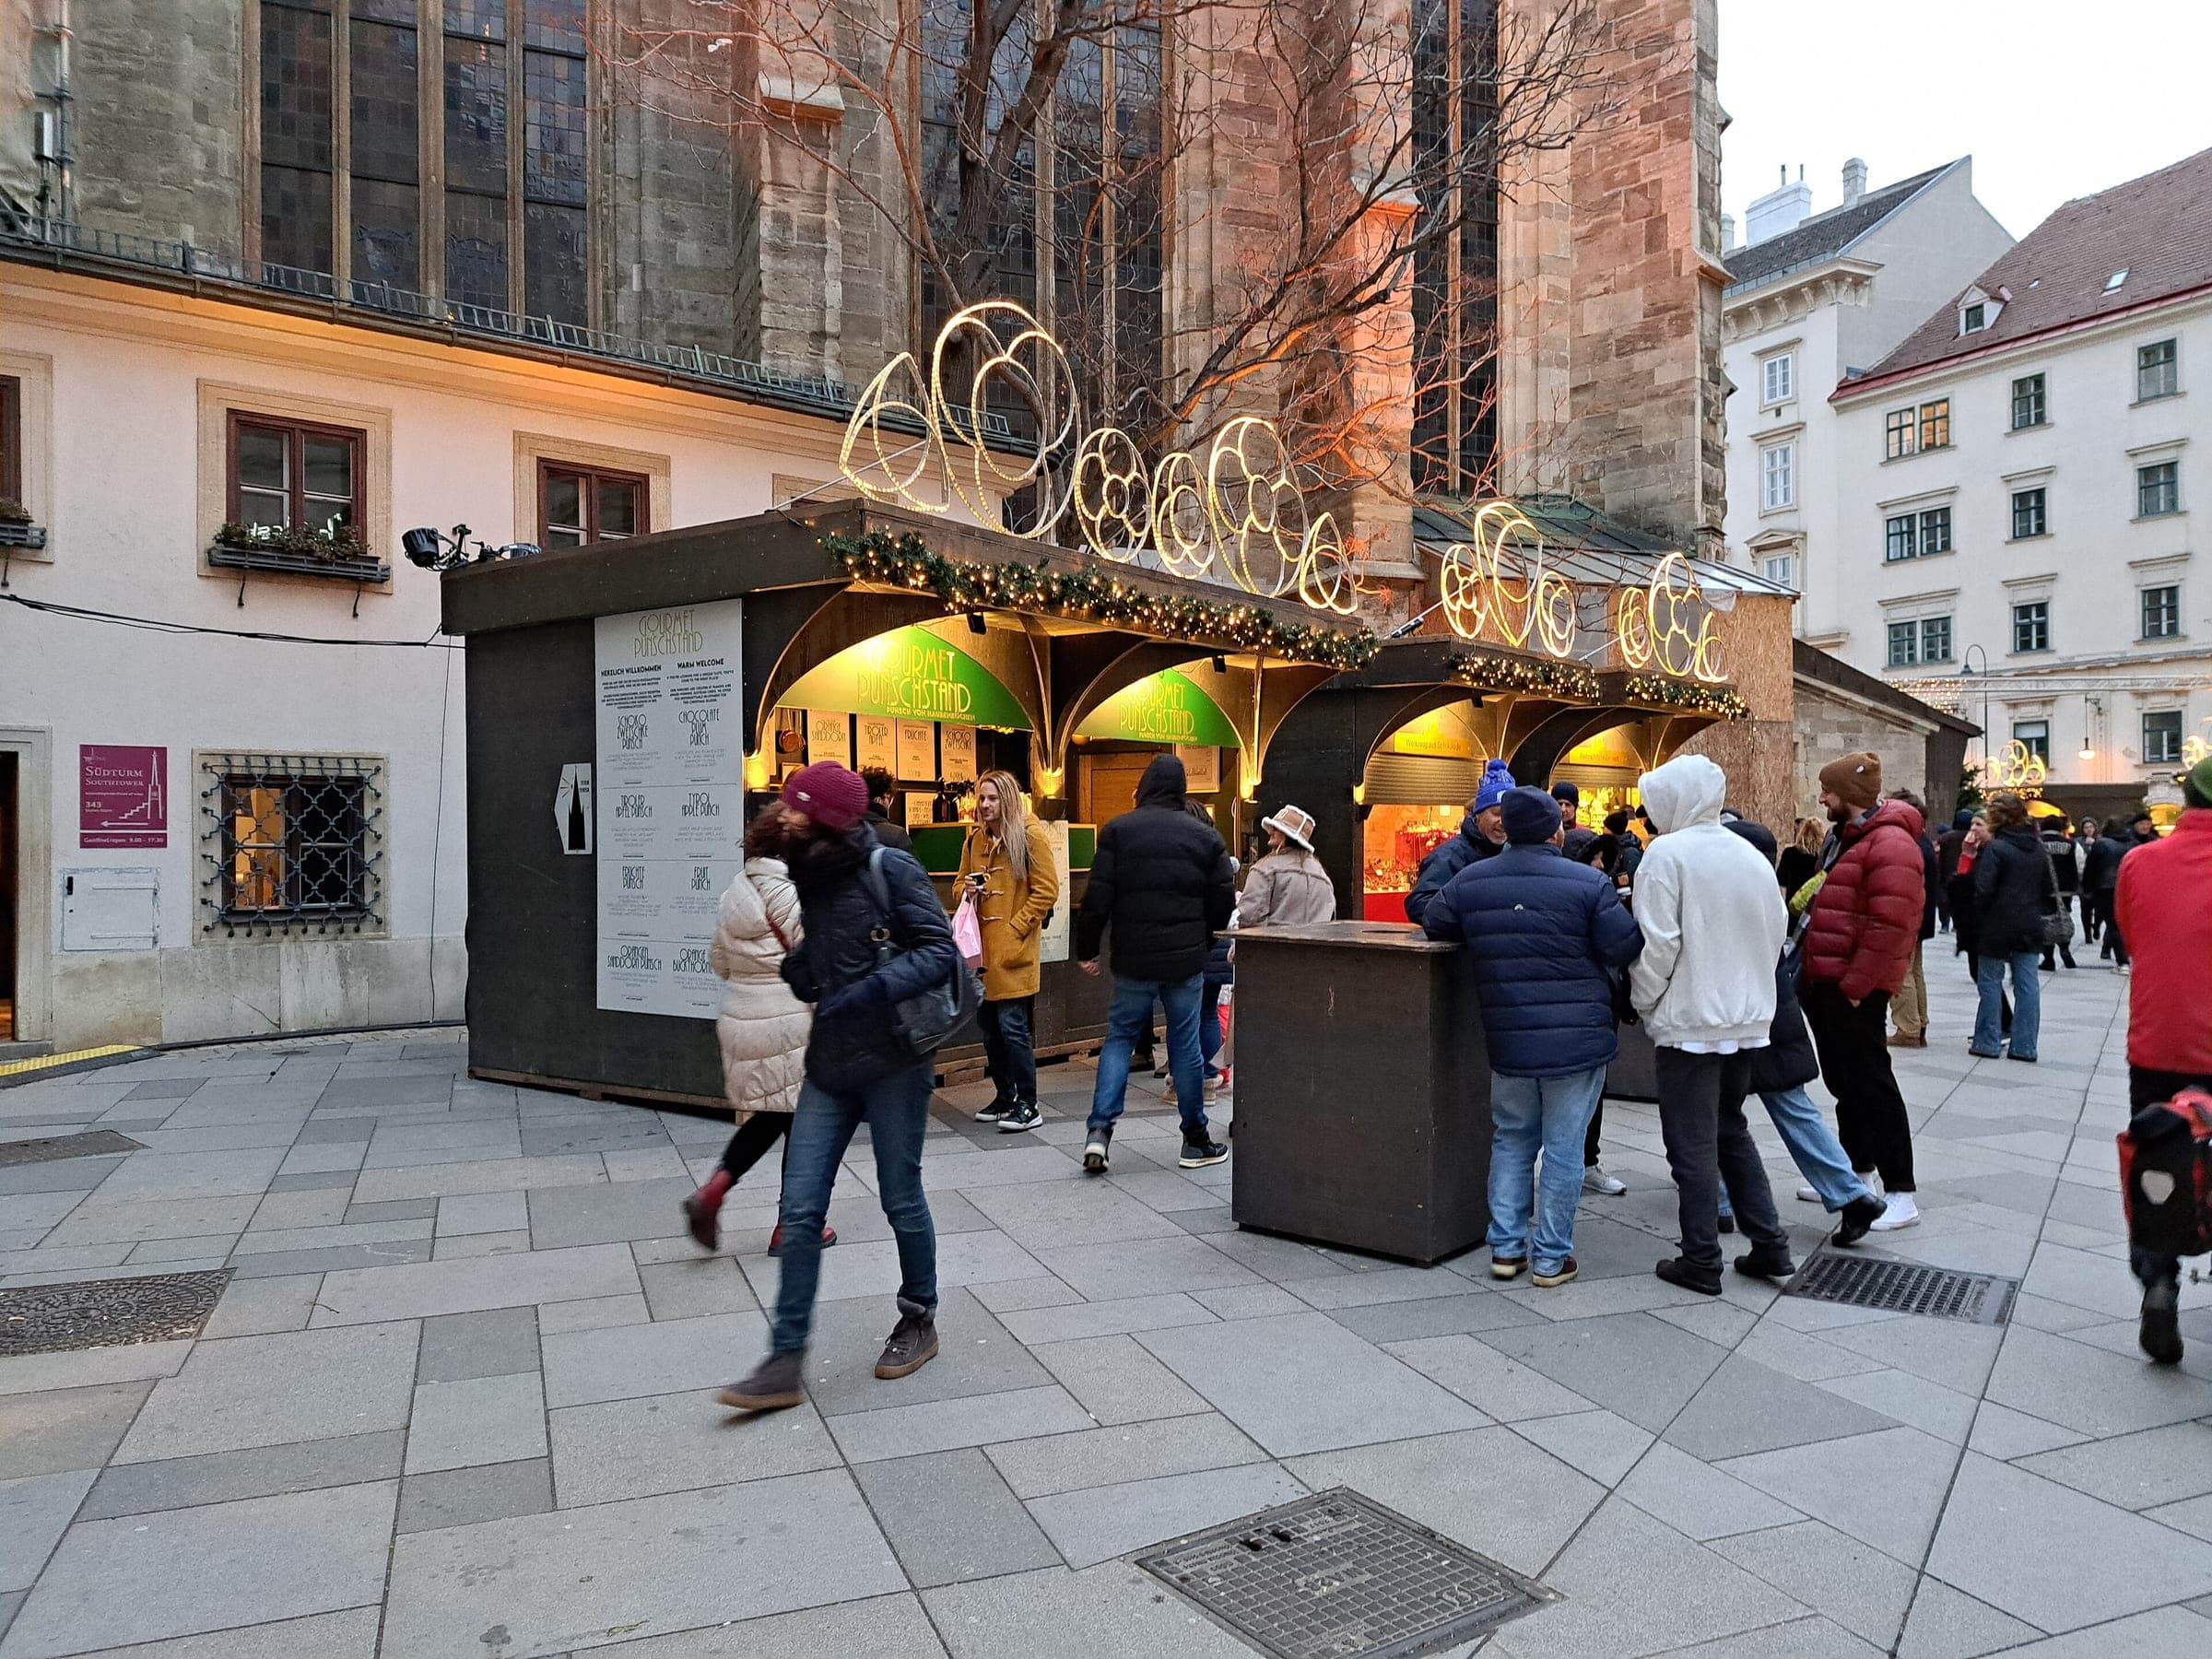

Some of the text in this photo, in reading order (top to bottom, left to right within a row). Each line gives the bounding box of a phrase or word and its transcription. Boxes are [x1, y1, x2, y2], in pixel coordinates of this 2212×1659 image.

[639, 609, 695, 637] GOURMET
[634, 630, 703, 658] PUNSCHSTAND
[677, 658, 724, 669] WARM WELCOME
[868, 642, 955, 681] GOURMET
[600, 665, 663, 677] HERZLICH WILLKOMMEN
[857, 671, 972, 714] PUNSCHSTAND
[618, 713, 647, 727] SCHOKO
[678, 708, 720, 724] CHOCOLATE
[1120, 703, 1194, 735] PUNSCHSTAND
[691, 722, 708, 735] PLUM
[85, 765, 144, 778] SÜDTURM
[85, 777, 145, 787] SOUTHTOWER
[693, 865, 709, 878] FRUIT
[619, 945, 649, 959] ORANGEN
[679, 947, 707, 961] ORANGE
[606, 955, 640, 969] SANDDORN
